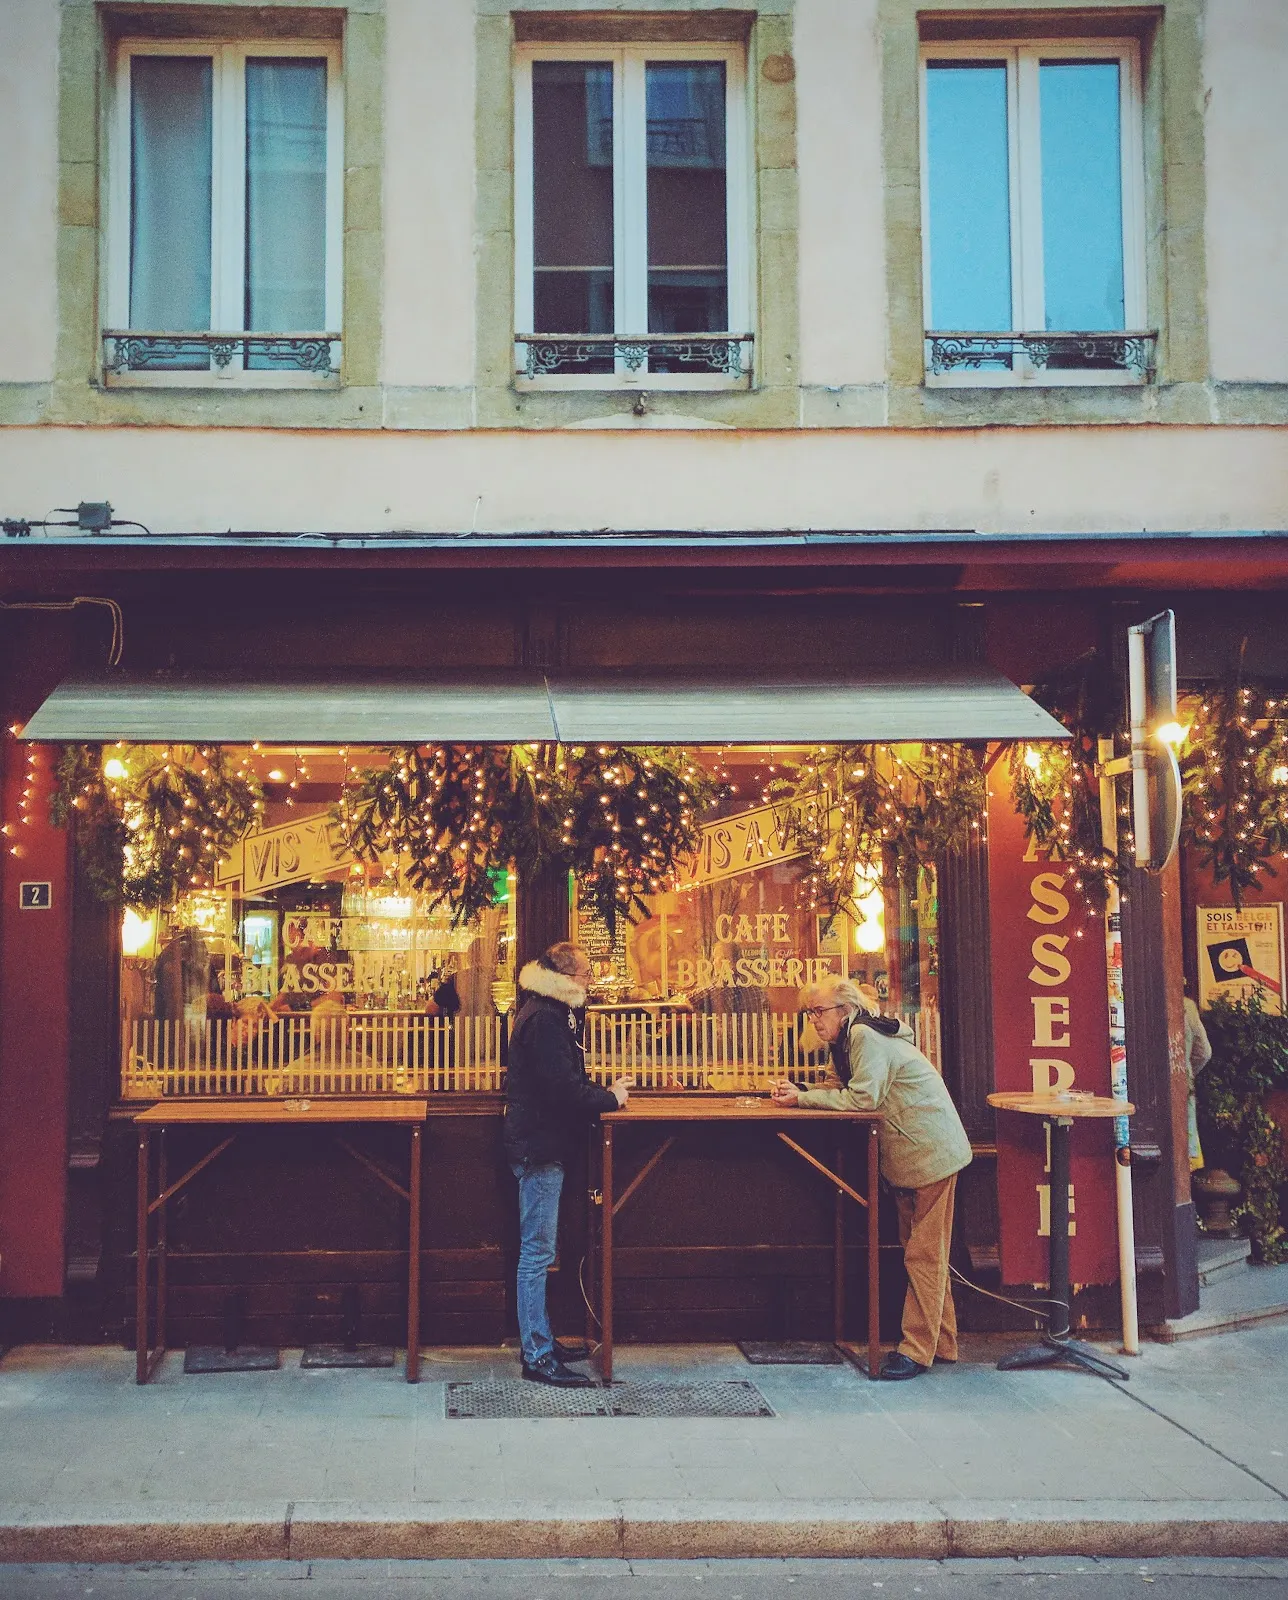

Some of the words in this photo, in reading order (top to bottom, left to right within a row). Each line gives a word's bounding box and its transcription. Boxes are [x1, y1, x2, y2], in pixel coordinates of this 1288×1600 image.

[250, 831, 301, 882] VIS
[31, 886, 40, 904] 2
[715, 906, 791, 943] CAFÉ
[1206, 912, 1233, 922] SOIS
[1236, 912, 1272, 921] BELGE
[1206, 922, 1218, 932] ET
[677, 957, 833, 988] BRASSERIE
